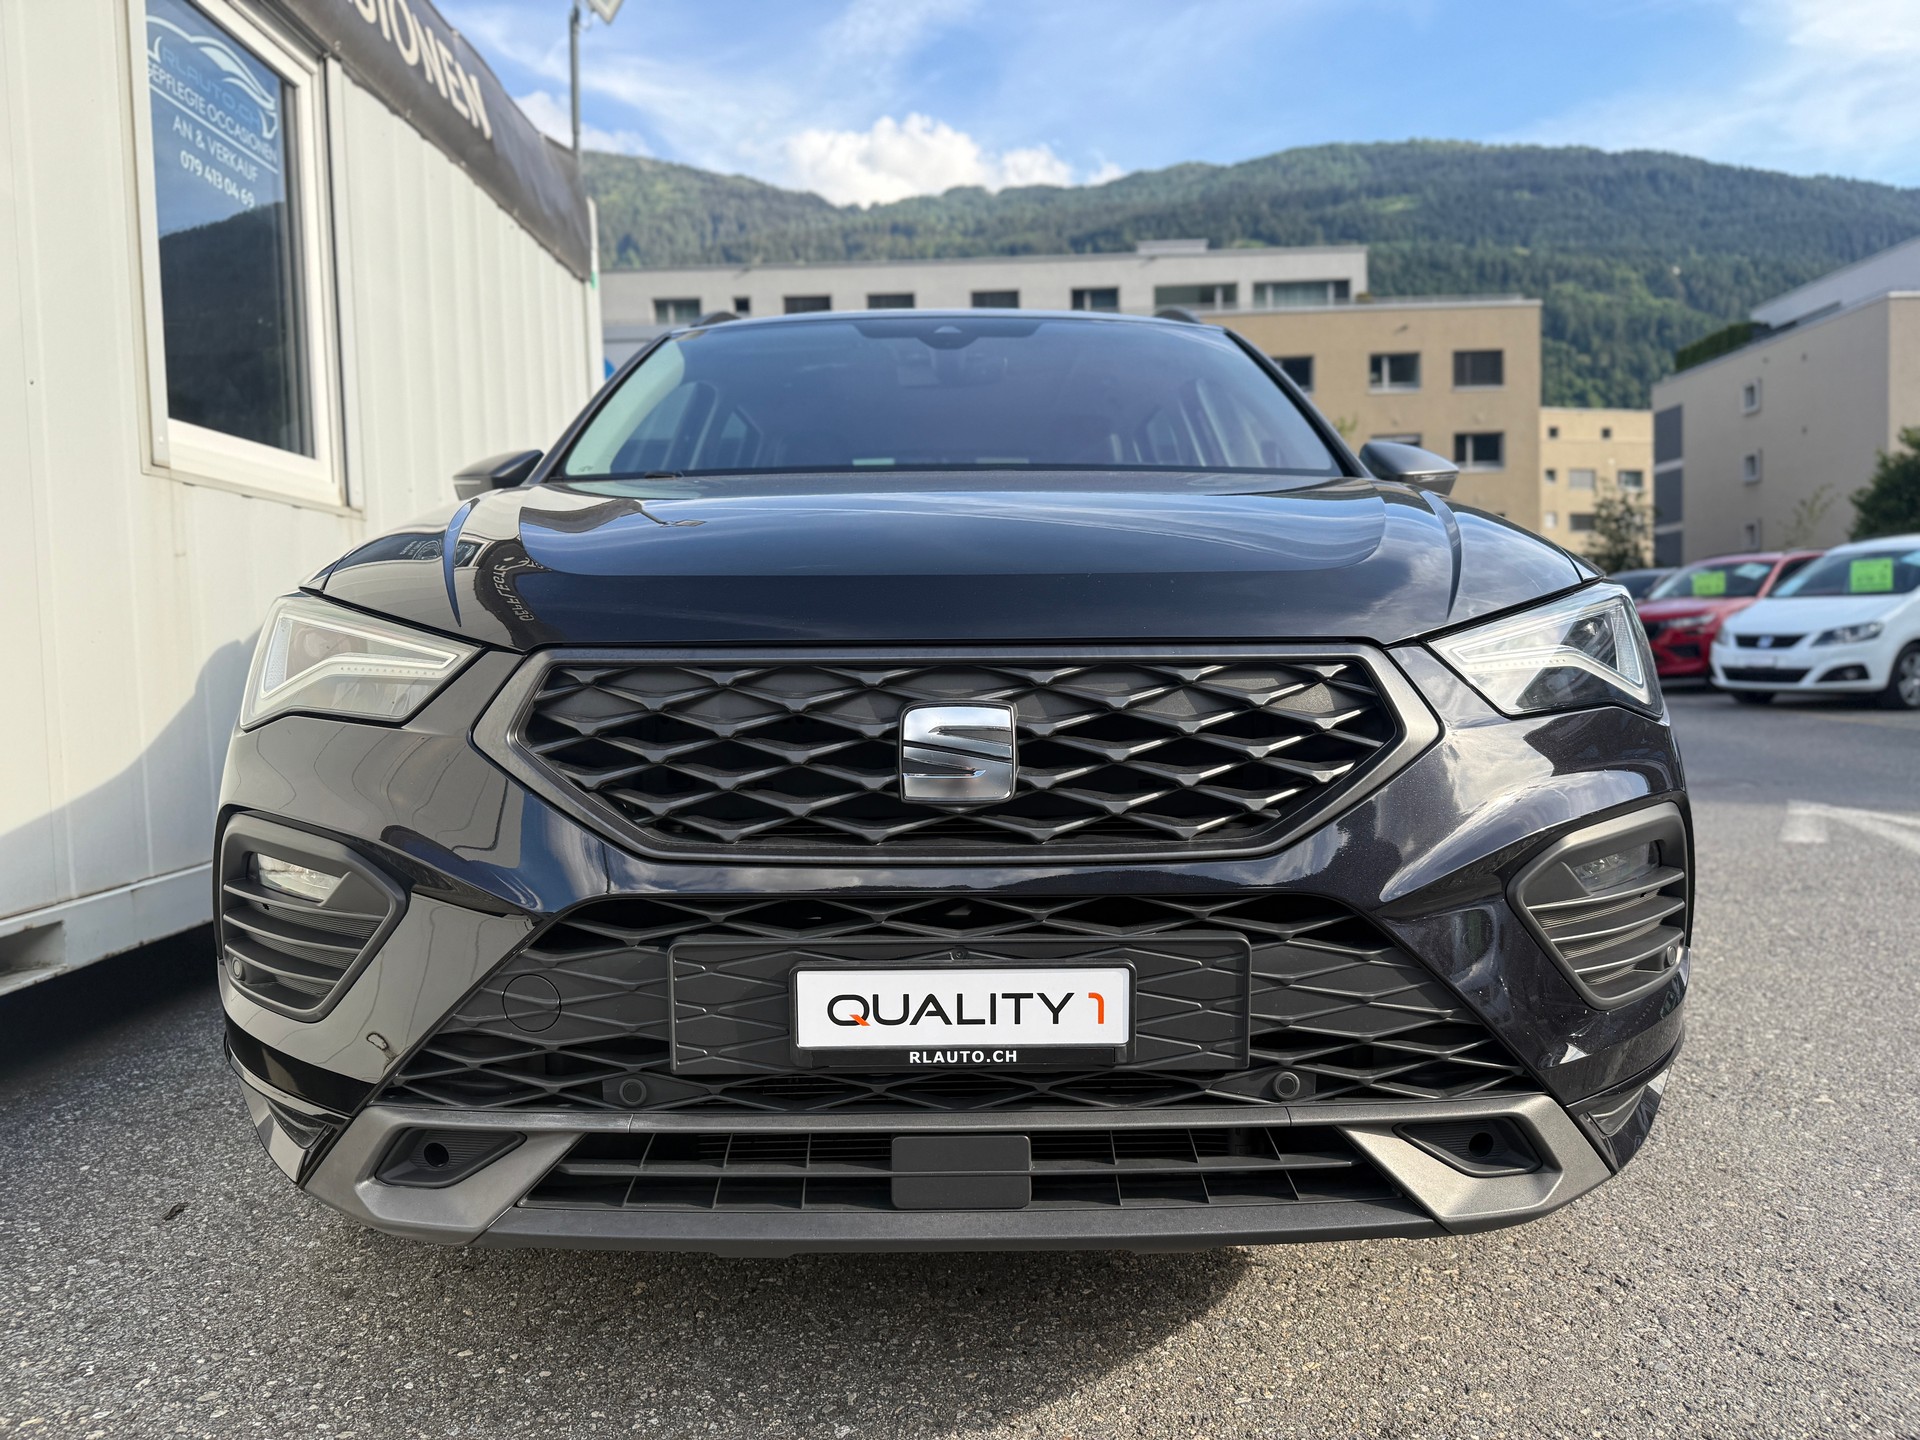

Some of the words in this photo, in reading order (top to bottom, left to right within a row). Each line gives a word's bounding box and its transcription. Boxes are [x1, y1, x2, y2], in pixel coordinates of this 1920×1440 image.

[172, 114, 193, 141] AN
[195, 129, 206, 150] &
[206, 136, 258, 182] VERKAUF
[180, 150, 203, 176] 079
[204, 165, 223, 190] 413
[223, 177, 239, 200] 04
[827, 992, 1075, 1026] QUALITY
[1088, 992, 1104, 1024] 1
[909, 1050, 1017, 1064] RLAUTO.CH
